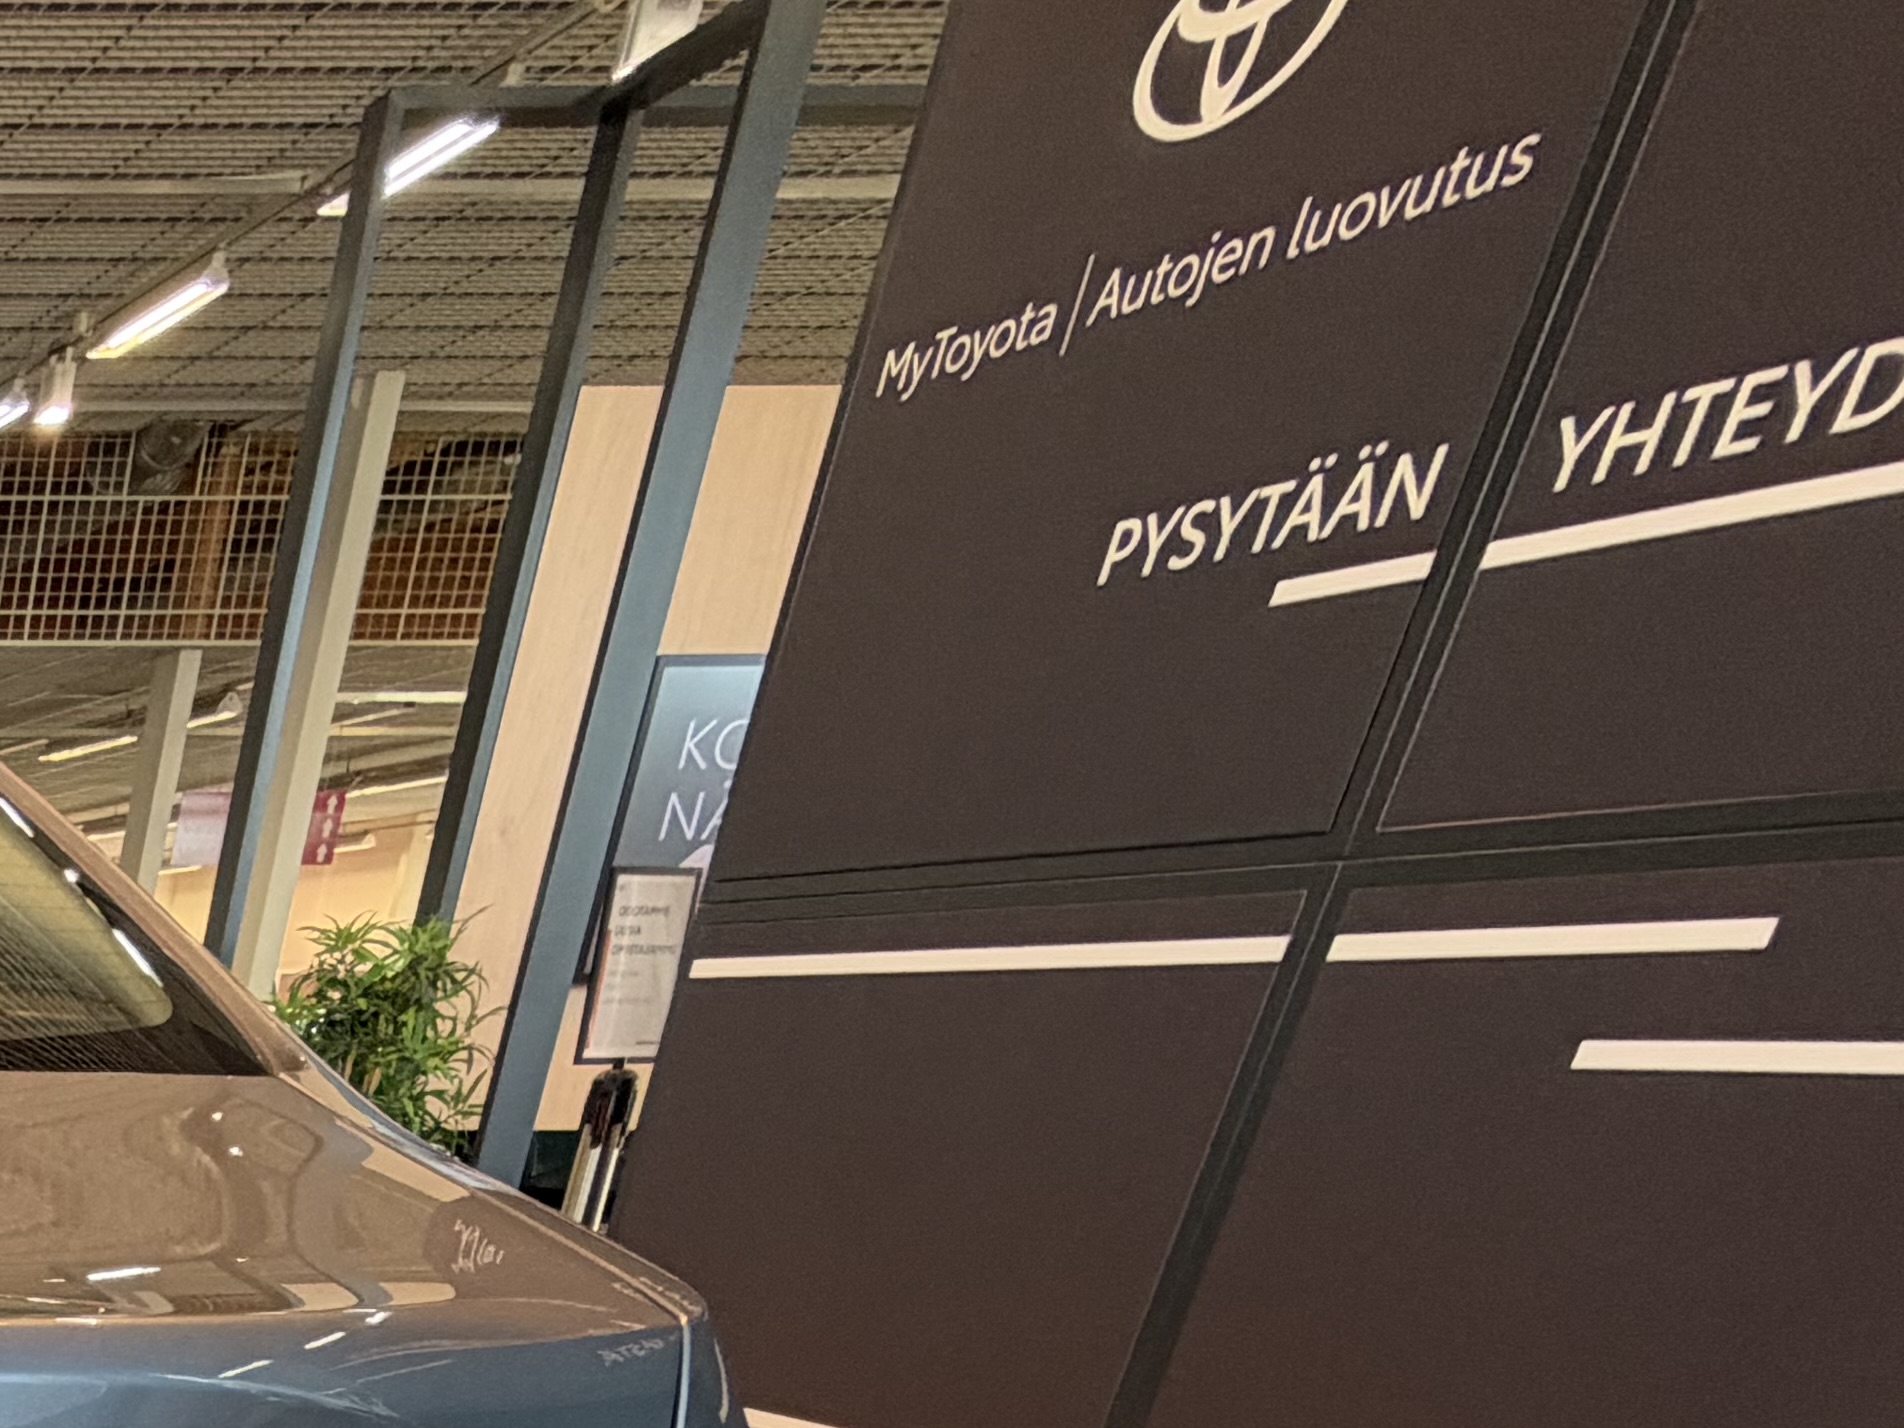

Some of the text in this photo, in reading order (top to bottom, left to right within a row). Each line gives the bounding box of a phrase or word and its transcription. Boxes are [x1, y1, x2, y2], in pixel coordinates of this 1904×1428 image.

[876, 133, 1542, 401] MyToyota Autojen luovutus
[1096, 336, 1904, 586] PYSYTÄÄN YHTEYD
